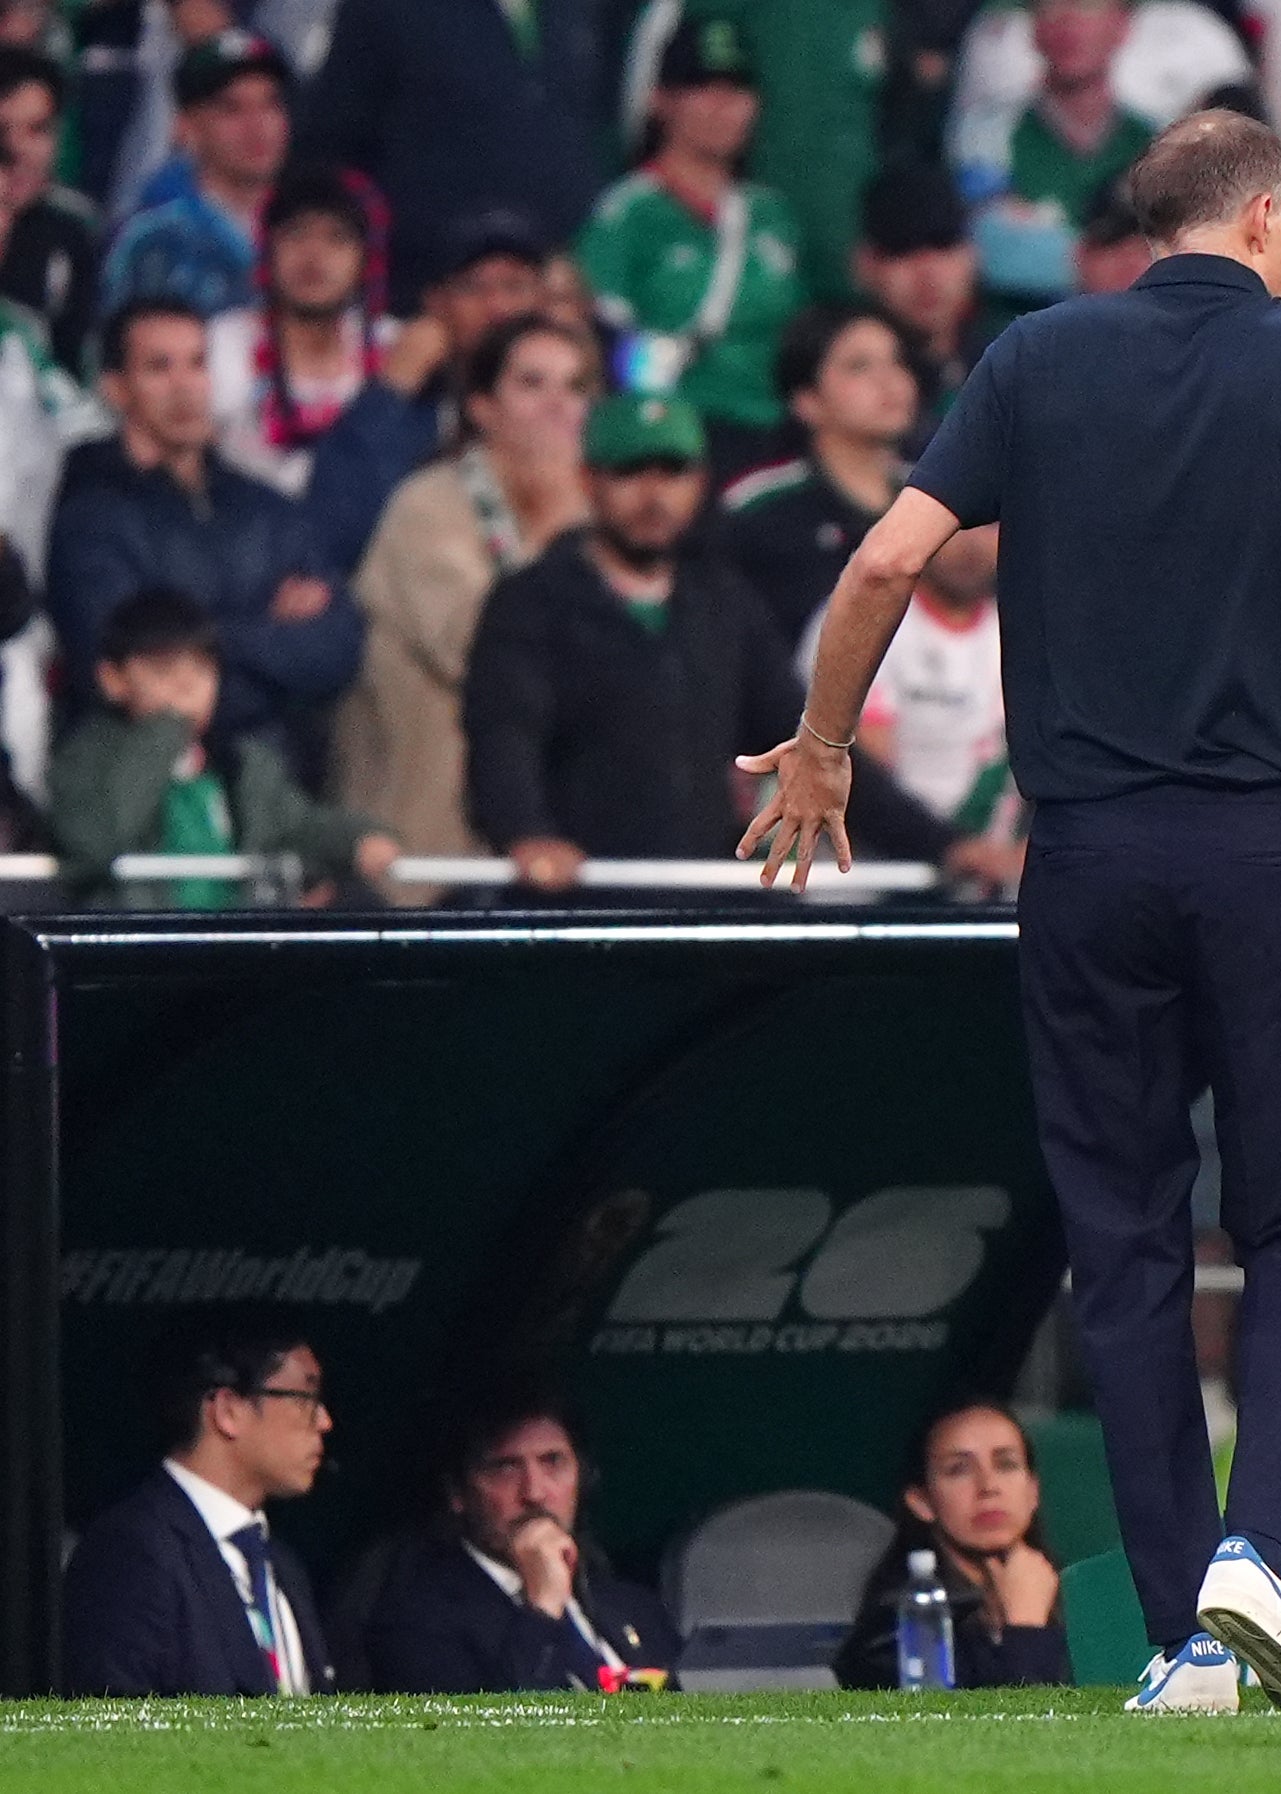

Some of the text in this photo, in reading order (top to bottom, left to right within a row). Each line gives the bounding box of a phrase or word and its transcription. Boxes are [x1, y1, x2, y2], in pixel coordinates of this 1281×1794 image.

[660, 1325, 774, 1353] WORLD
[774, 1324, 839, 1352] CUP
[837, 1322, 950, 1352] 2026
[1191, 1640, 1225, 1657] NIKE
